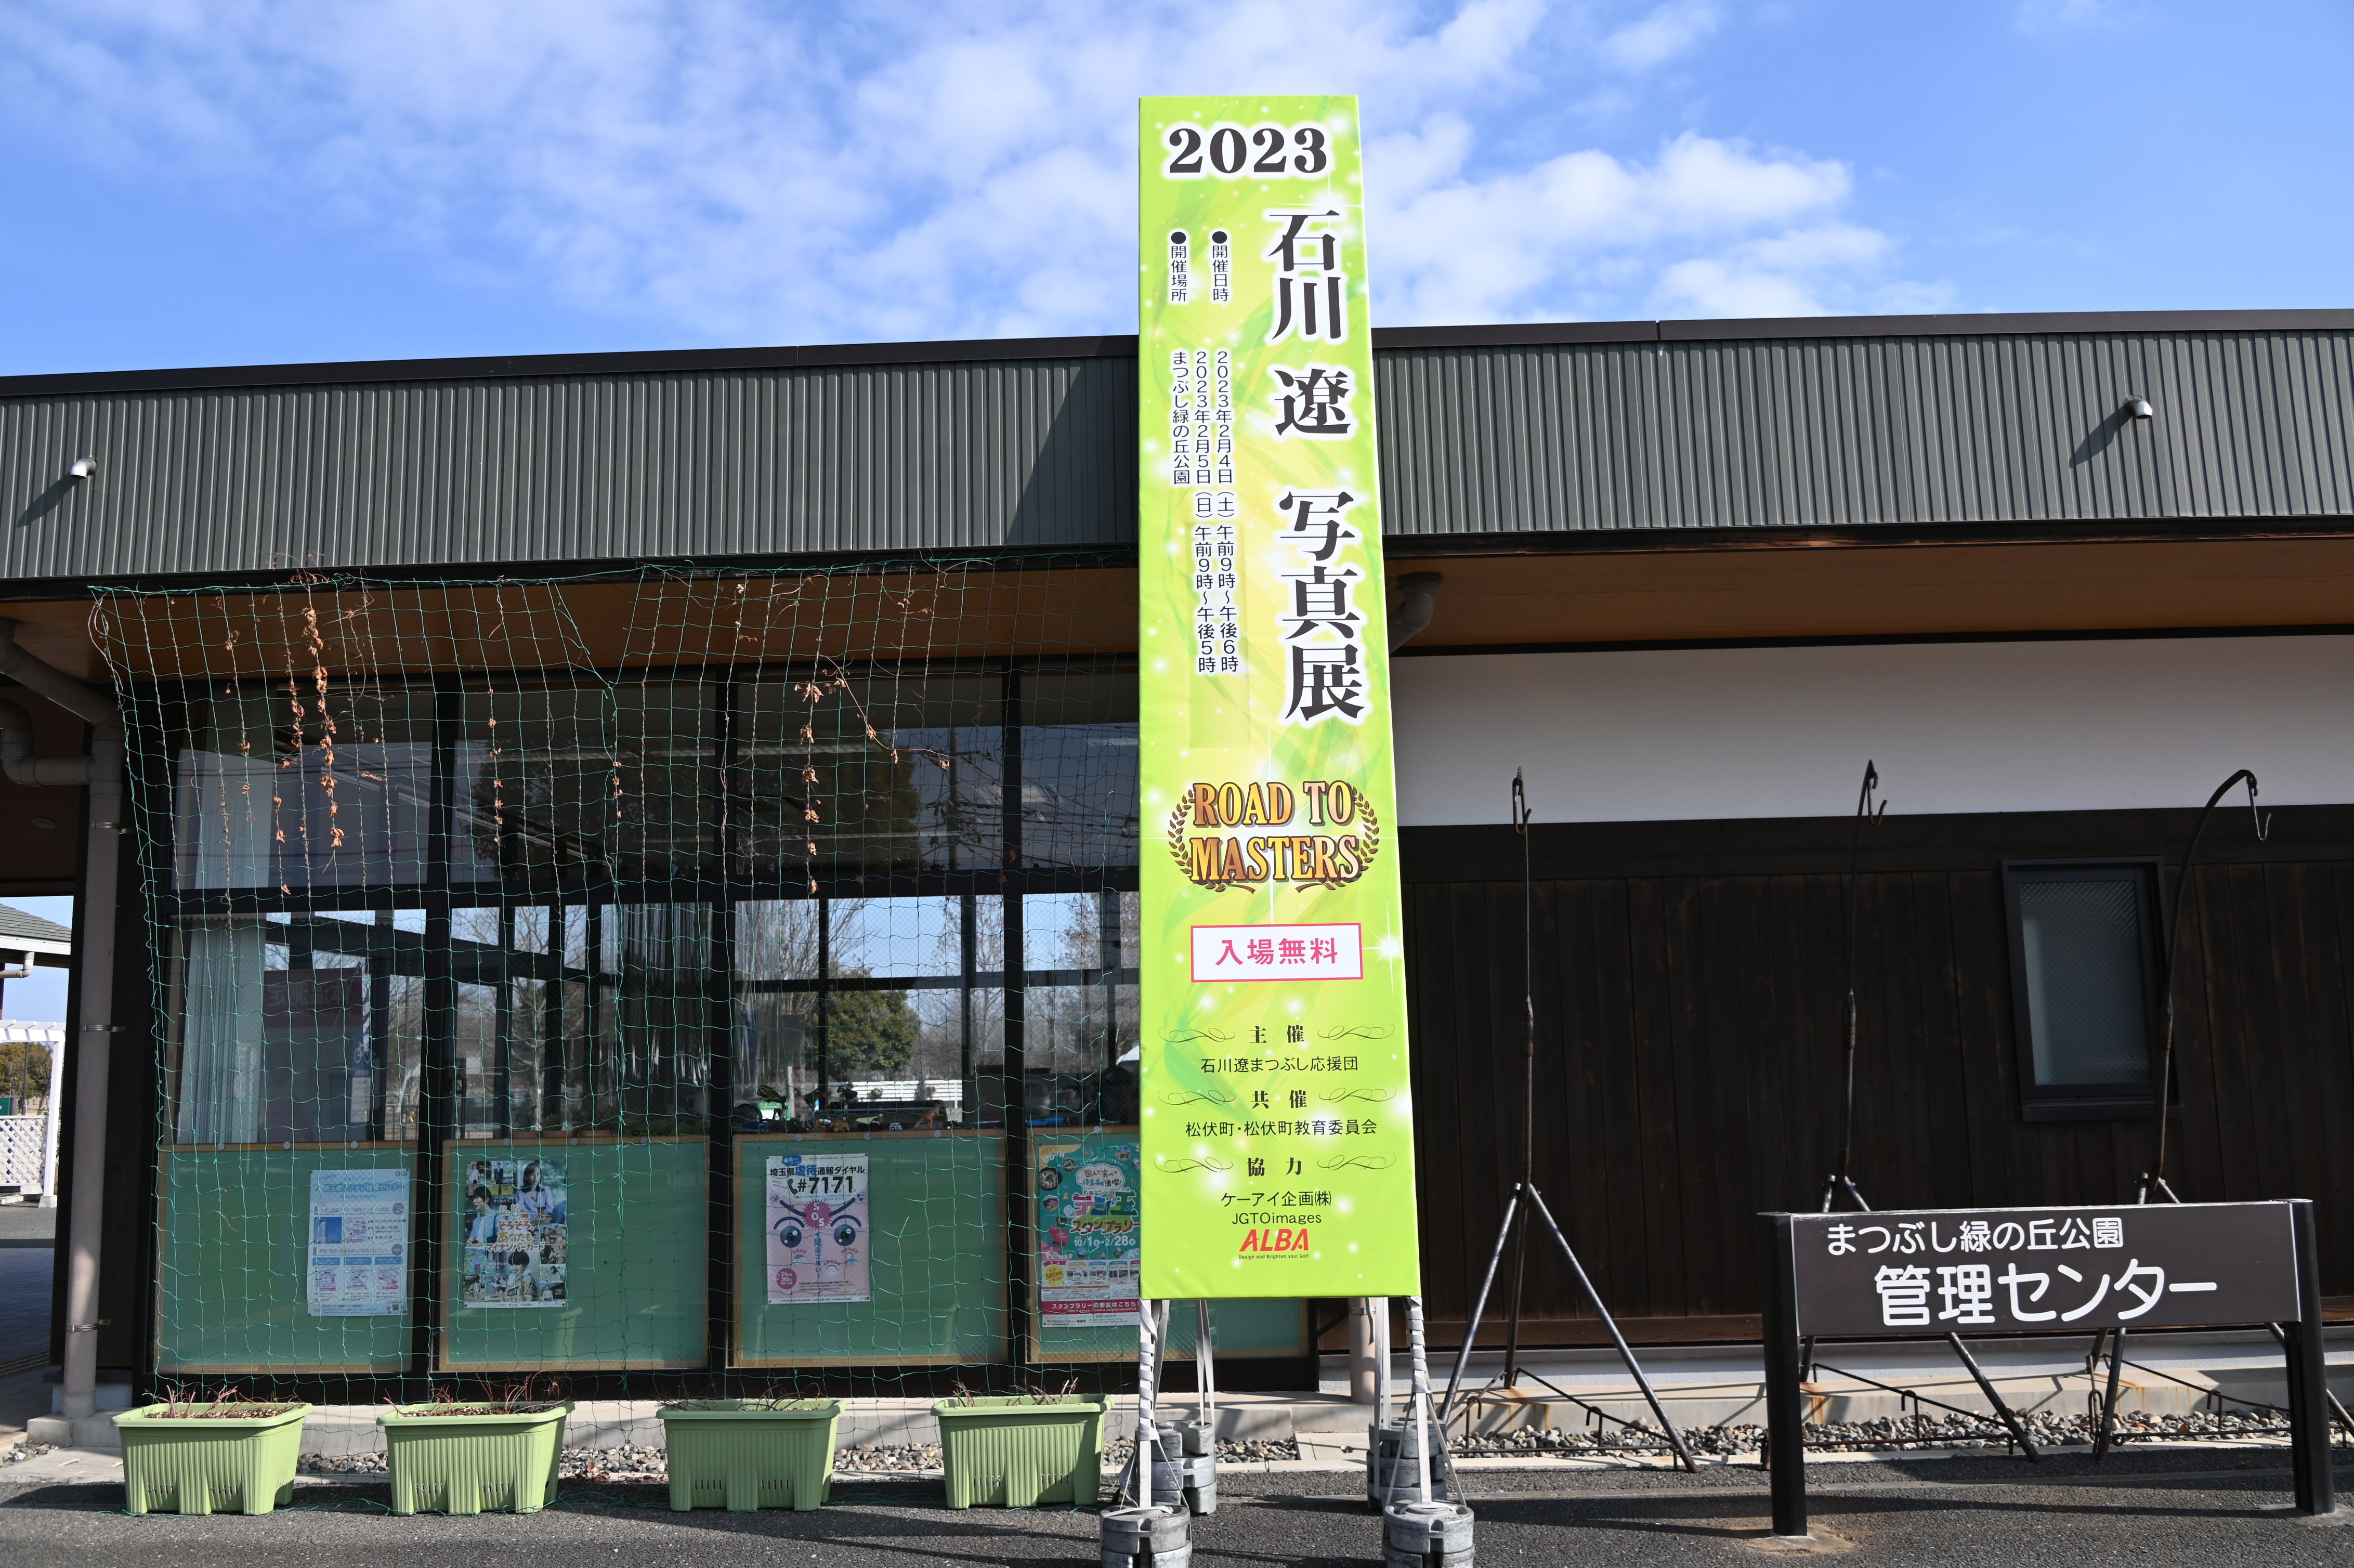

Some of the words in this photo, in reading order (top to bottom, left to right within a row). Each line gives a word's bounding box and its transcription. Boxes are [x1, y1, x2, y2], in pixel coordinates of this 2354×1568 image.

[1169, 128, 1327, 174] 2023
[1173, 351, 1190, 485] まつぶし緑の丘公園
[1279, 491, 1365, 721] 写真展
[1193, 781, 1293, 827] ROAD
[1303, 780, 1353, 826] TO
[1189, 835, 1361, 882] MASTERS
[1215, 937, 1338, 966] 入場無料
[1200, 1056, 1358, 1073] 石川遼まつぶし応援団
[1185, 1119, 1377, 1137] 松伏町・松伏町教育委員会
[770, 1165, 865, 1177] 埼玉県虐待通報ダイヤル
[1232, 1212, 1322, 1225] JGTOimages
[498, 1232, 533, 1243] あなたも
[1239, 1229, 1309, 1251] ALBA
[1827, 1217, 2124, 1256] まつぶし緑の丘公園
[1874, 1258, 2217, 1326] 管理センター
